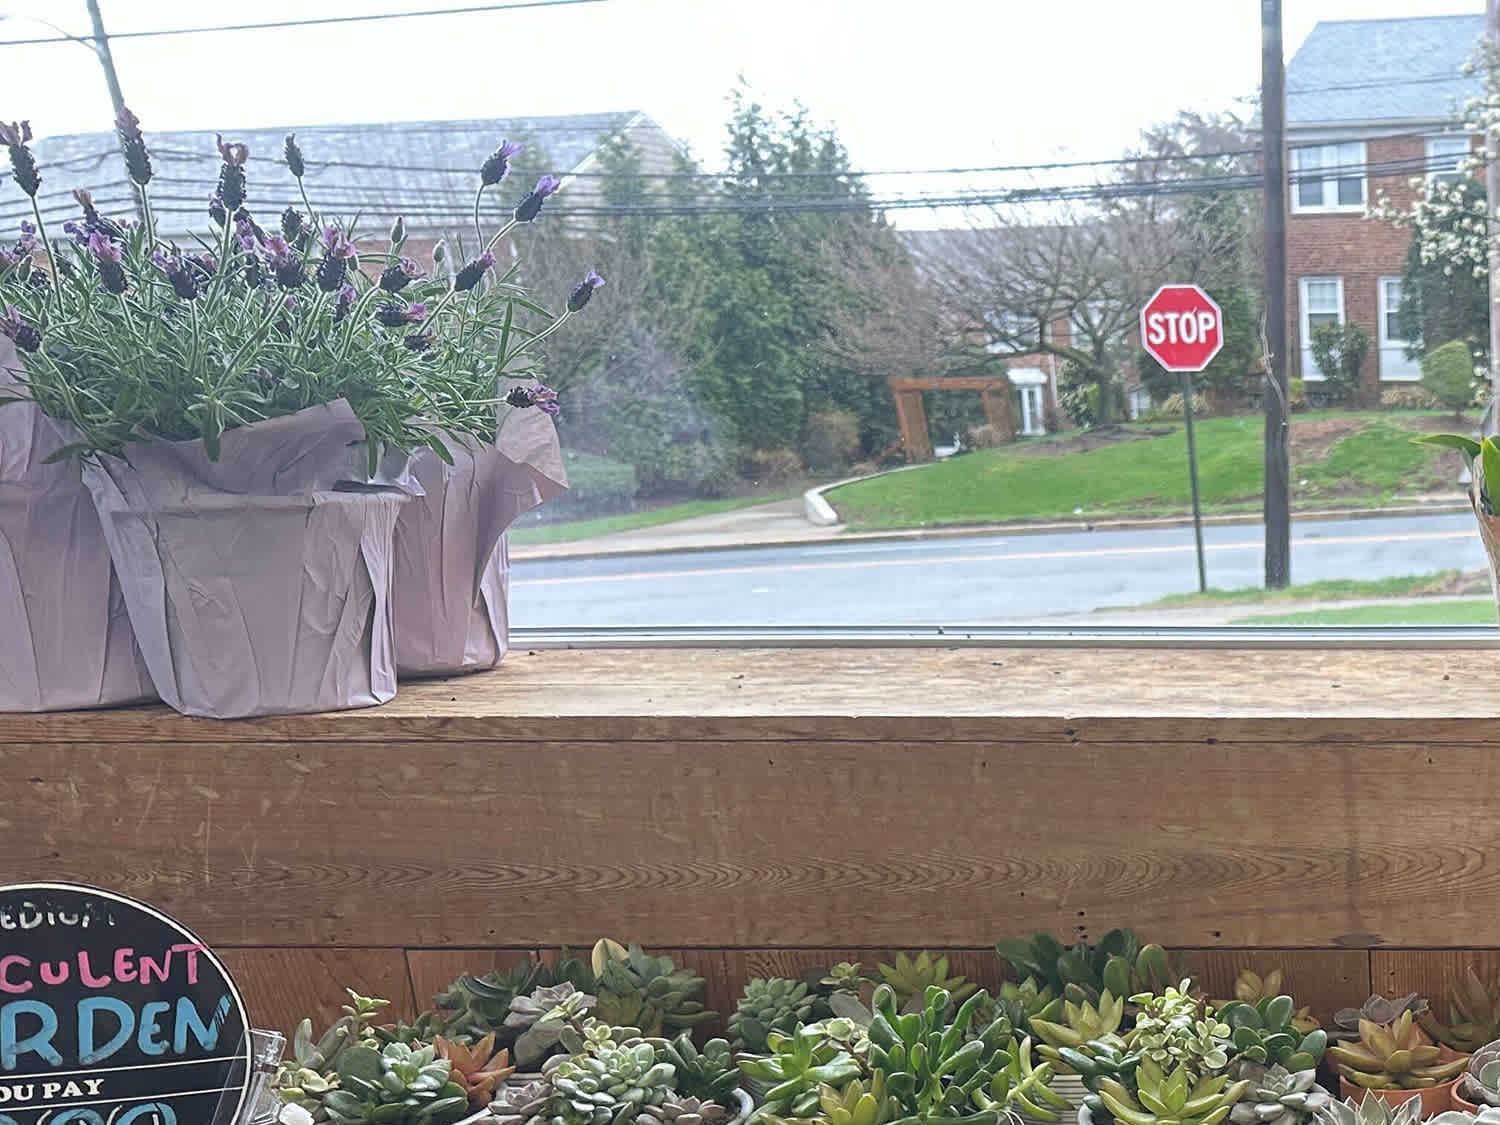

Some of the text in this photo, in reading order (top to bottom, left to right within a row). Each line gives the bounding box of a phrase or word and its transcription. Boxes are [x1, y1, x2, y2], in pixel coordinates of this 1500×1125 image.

[1148, 312, 1216, 344] STOP
[1, 995, 232, 1071] RDEN
[42, 1079, 104, 1099] PAY
